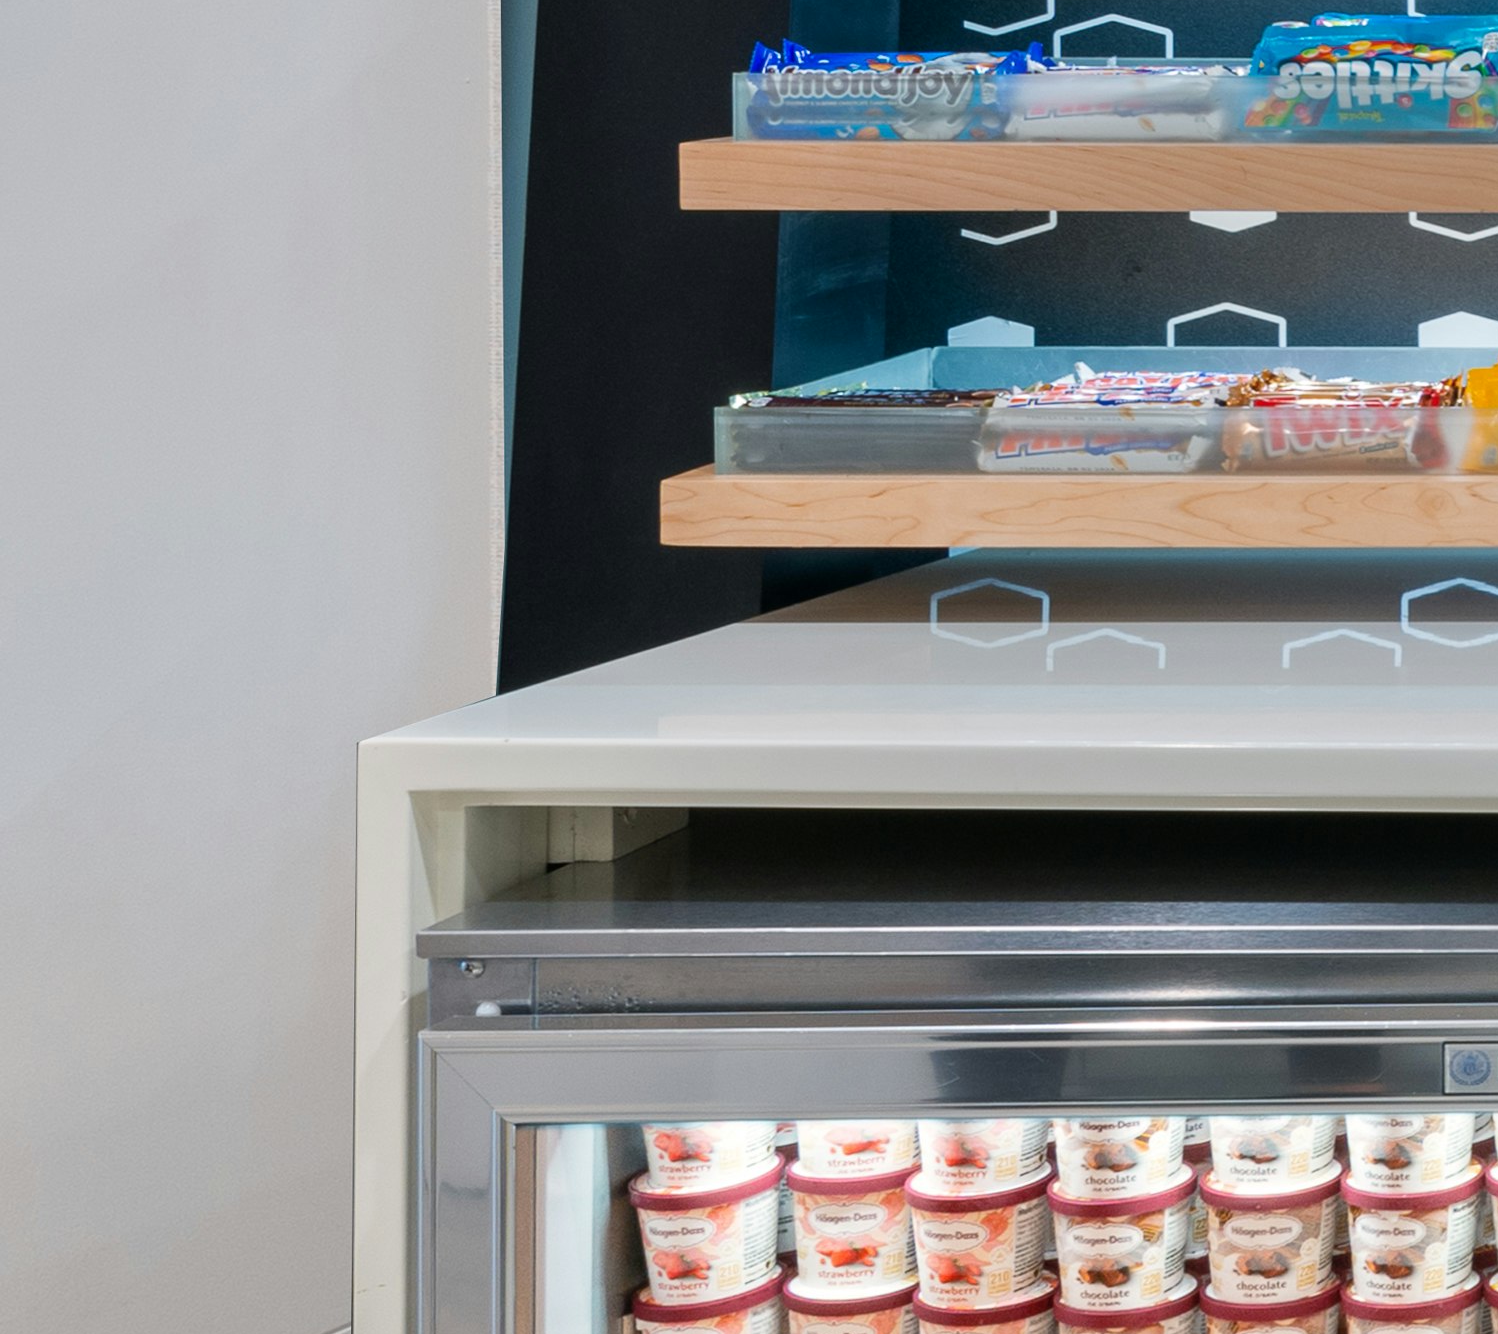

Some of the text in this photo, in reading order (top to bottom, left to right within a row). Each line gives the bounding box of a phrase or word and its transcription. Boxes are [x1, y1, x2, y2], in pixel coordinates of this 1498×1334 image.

[1085, 1175, 1137, 1186] chocolate
[658, 1282, 709, 1292] strawberry
[1237, 1280, 1287, 1290] chocolate
